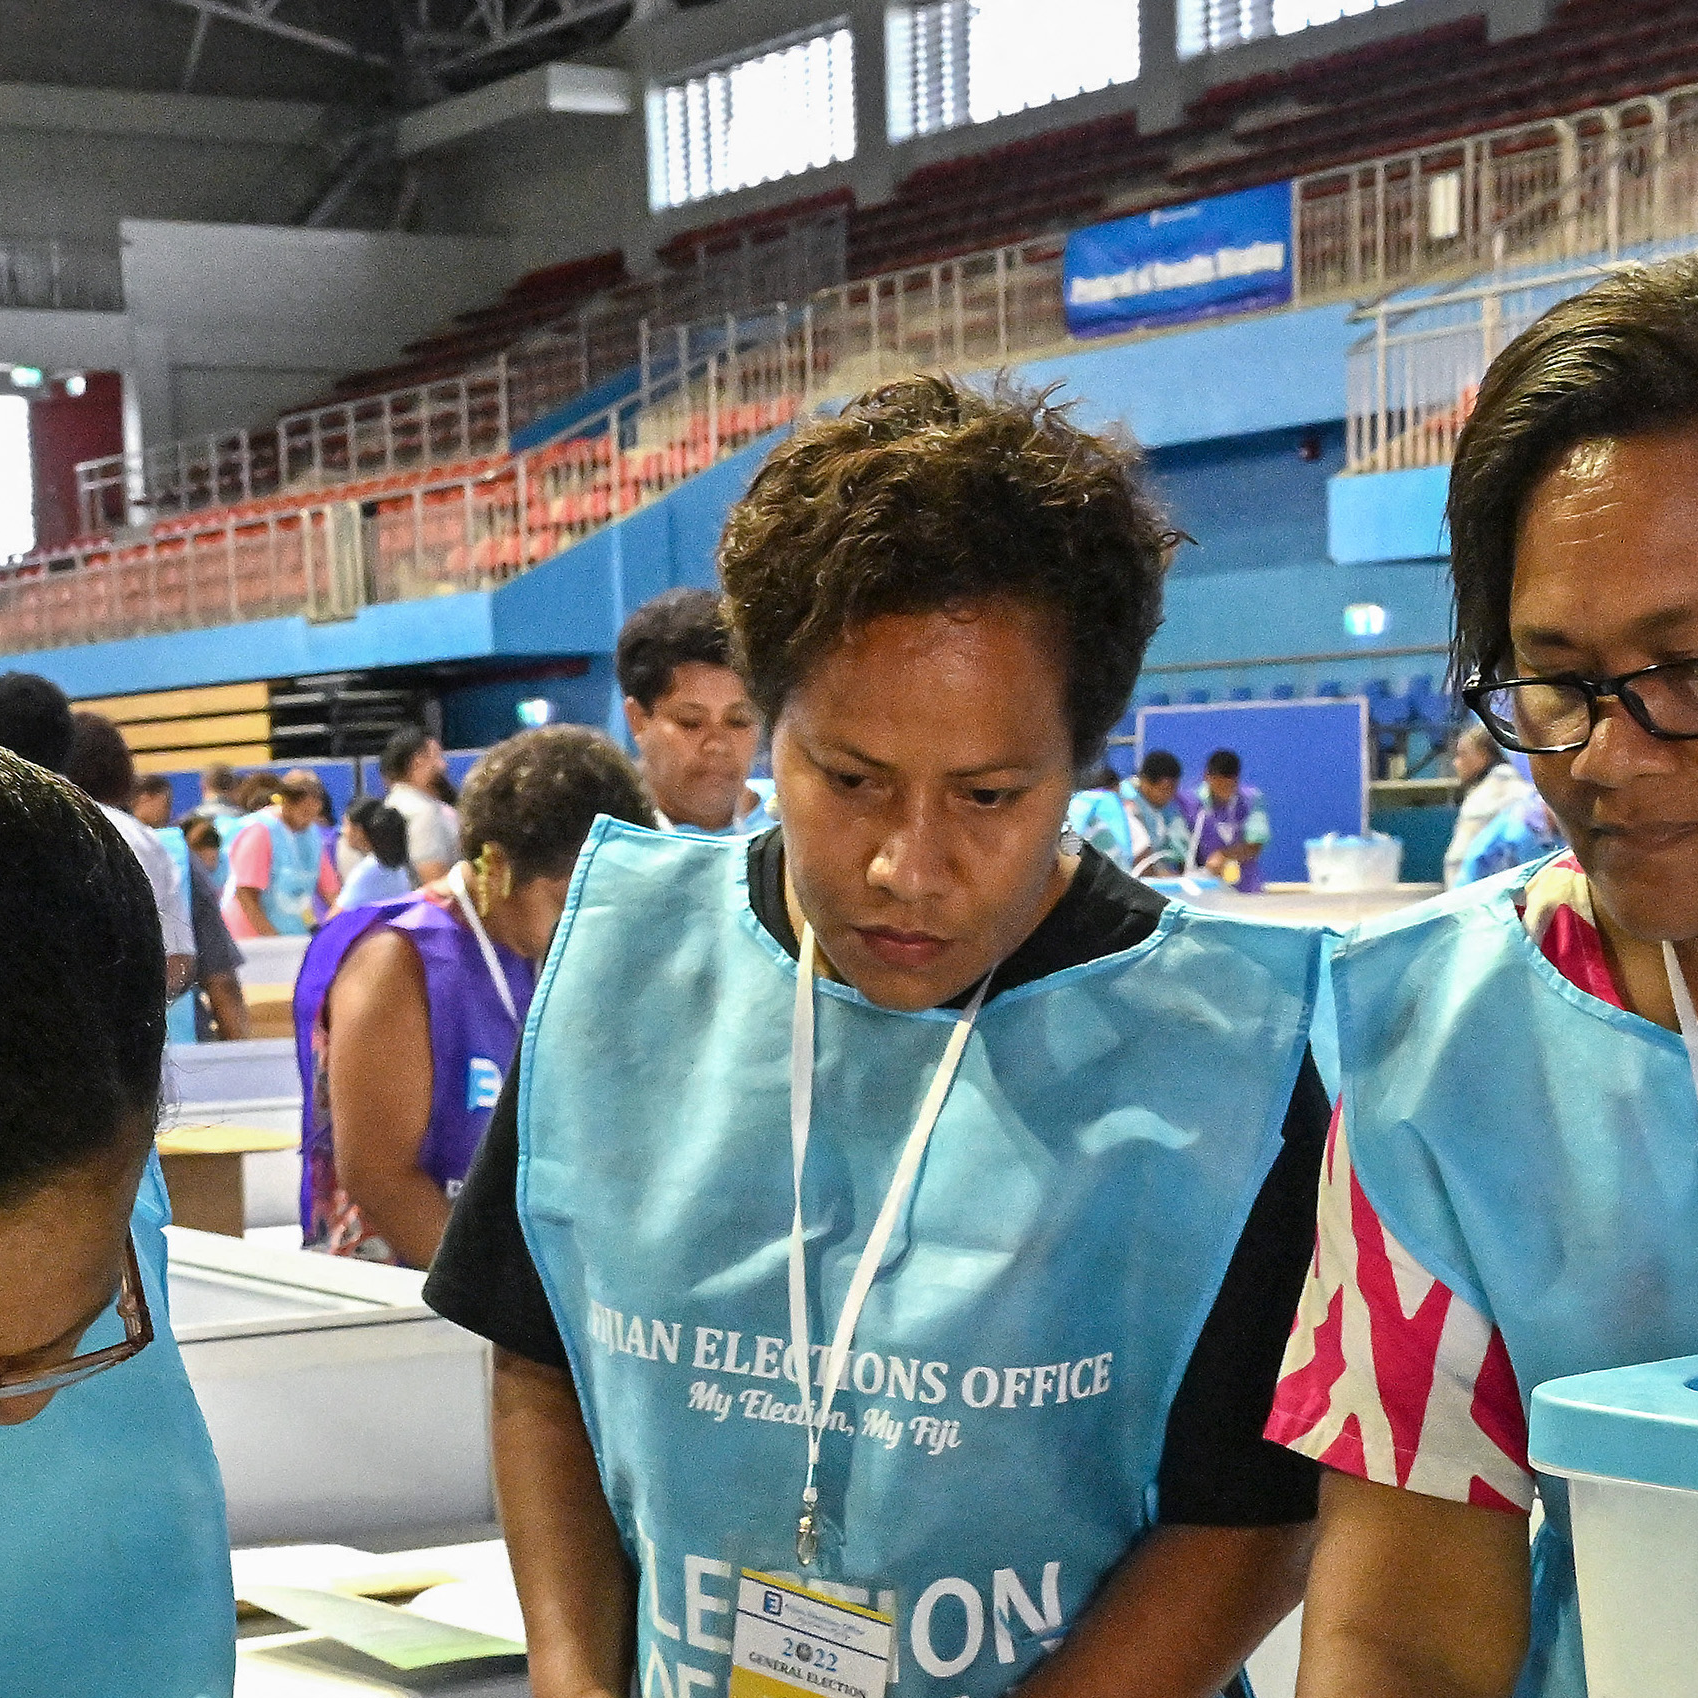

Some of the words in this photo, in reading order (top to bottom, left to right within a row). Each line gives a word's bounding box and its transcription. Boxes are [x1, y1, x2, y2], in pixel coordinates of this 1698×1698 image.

[961, 1352, 1113, 1409] OFFICE
[688, 1381, 733, 1423] My
[862, 1407, 904, 1450] My
[909, 1415, 961, 1455] Fiji
[749, 1652, 804, 1679] GENERAL
[807, 1671, 866, 1698] ELECTION
